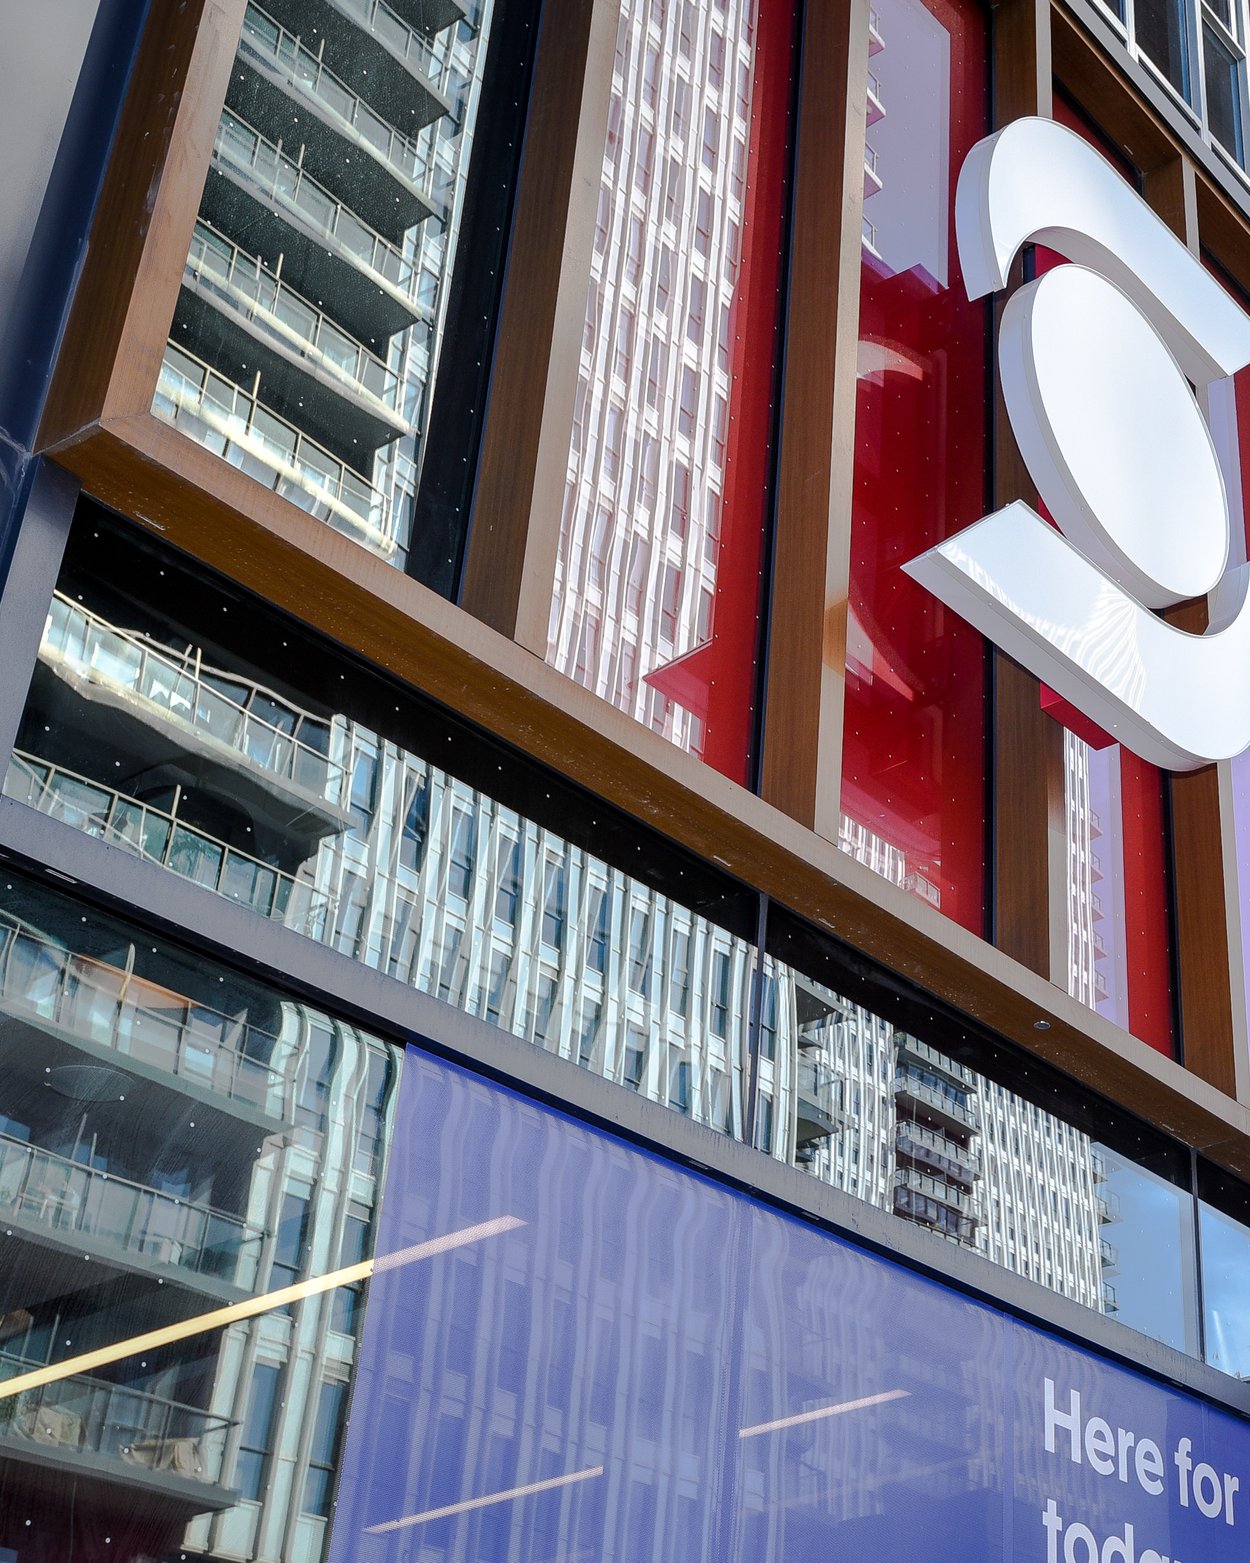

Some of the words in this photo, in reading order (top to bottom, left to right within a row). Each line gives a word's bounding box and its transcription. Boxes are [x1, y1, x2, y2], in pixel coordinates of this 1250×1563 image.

[1044, 1377, 1164, 1495] Here
[1174, 1437, 1239, 1526] for
[1042, 1498, 1182, 1563] tod
